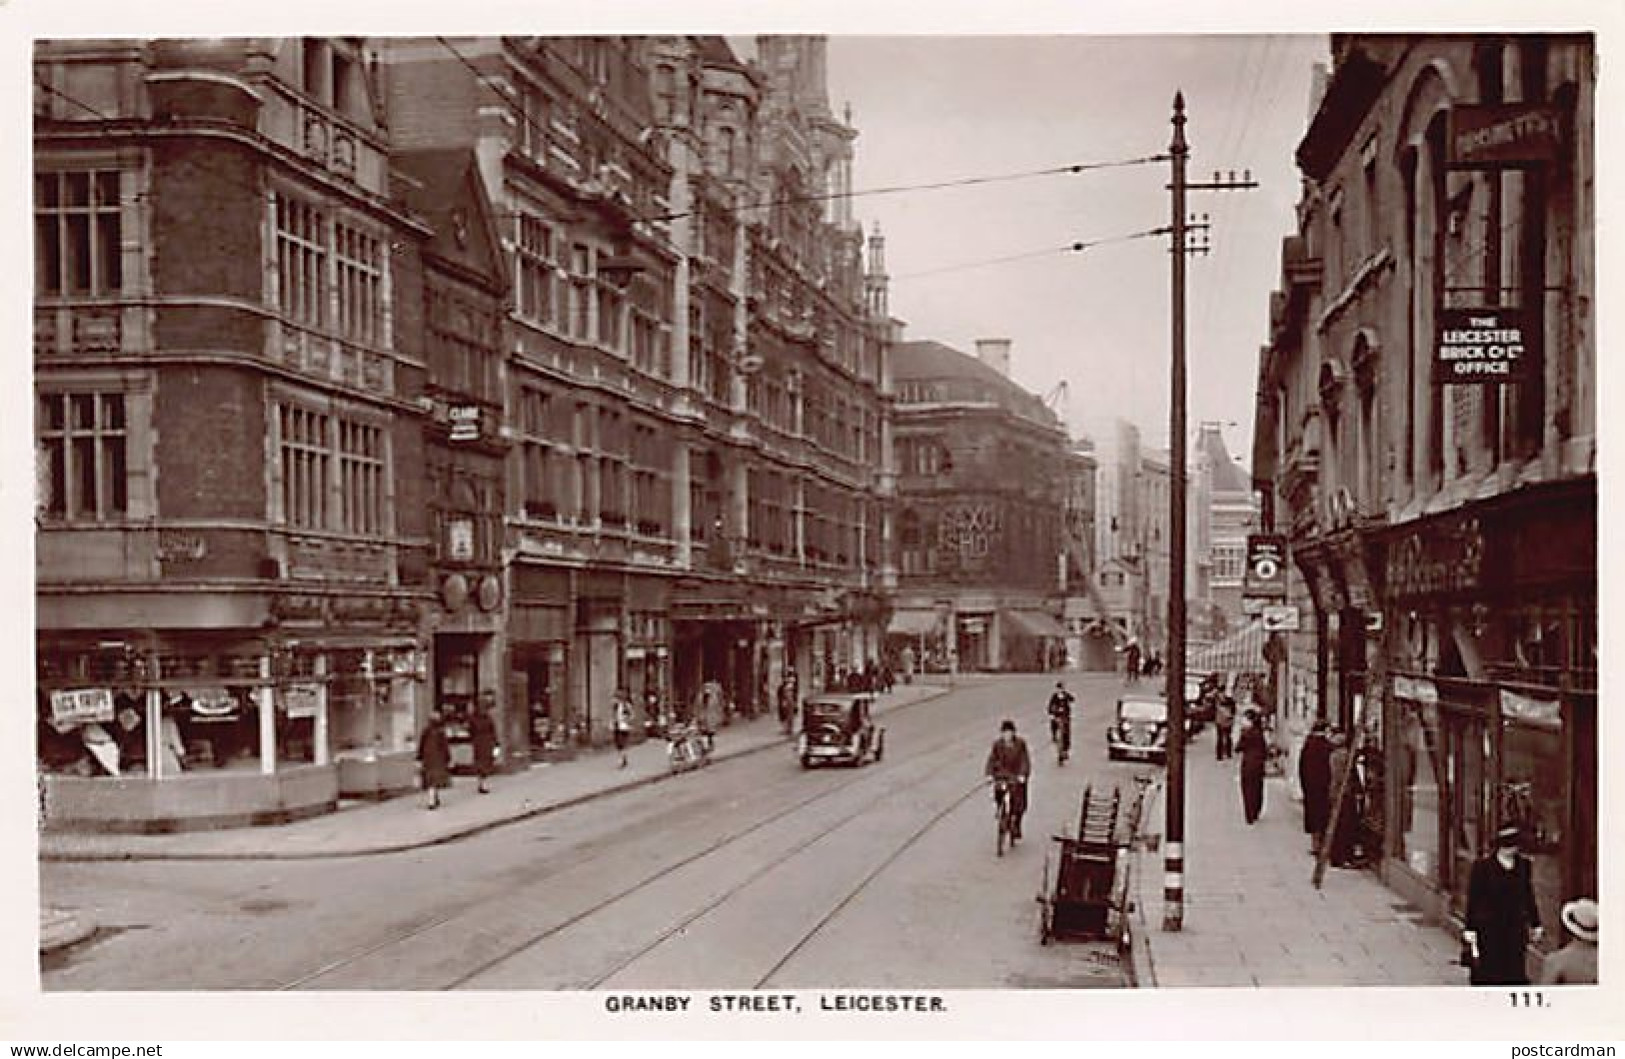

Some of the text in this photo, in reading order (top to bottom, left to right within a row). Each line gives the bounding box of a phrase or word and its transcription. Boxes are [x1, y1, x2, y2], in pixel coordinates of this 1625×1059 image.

[1470, 317, 1497, 328] THE
[1442, 329, 1521, 344] LEICESTER
[1440, 345, 1485, 360] BRICK
[1453, 361, 1509, 375] OFFICE
